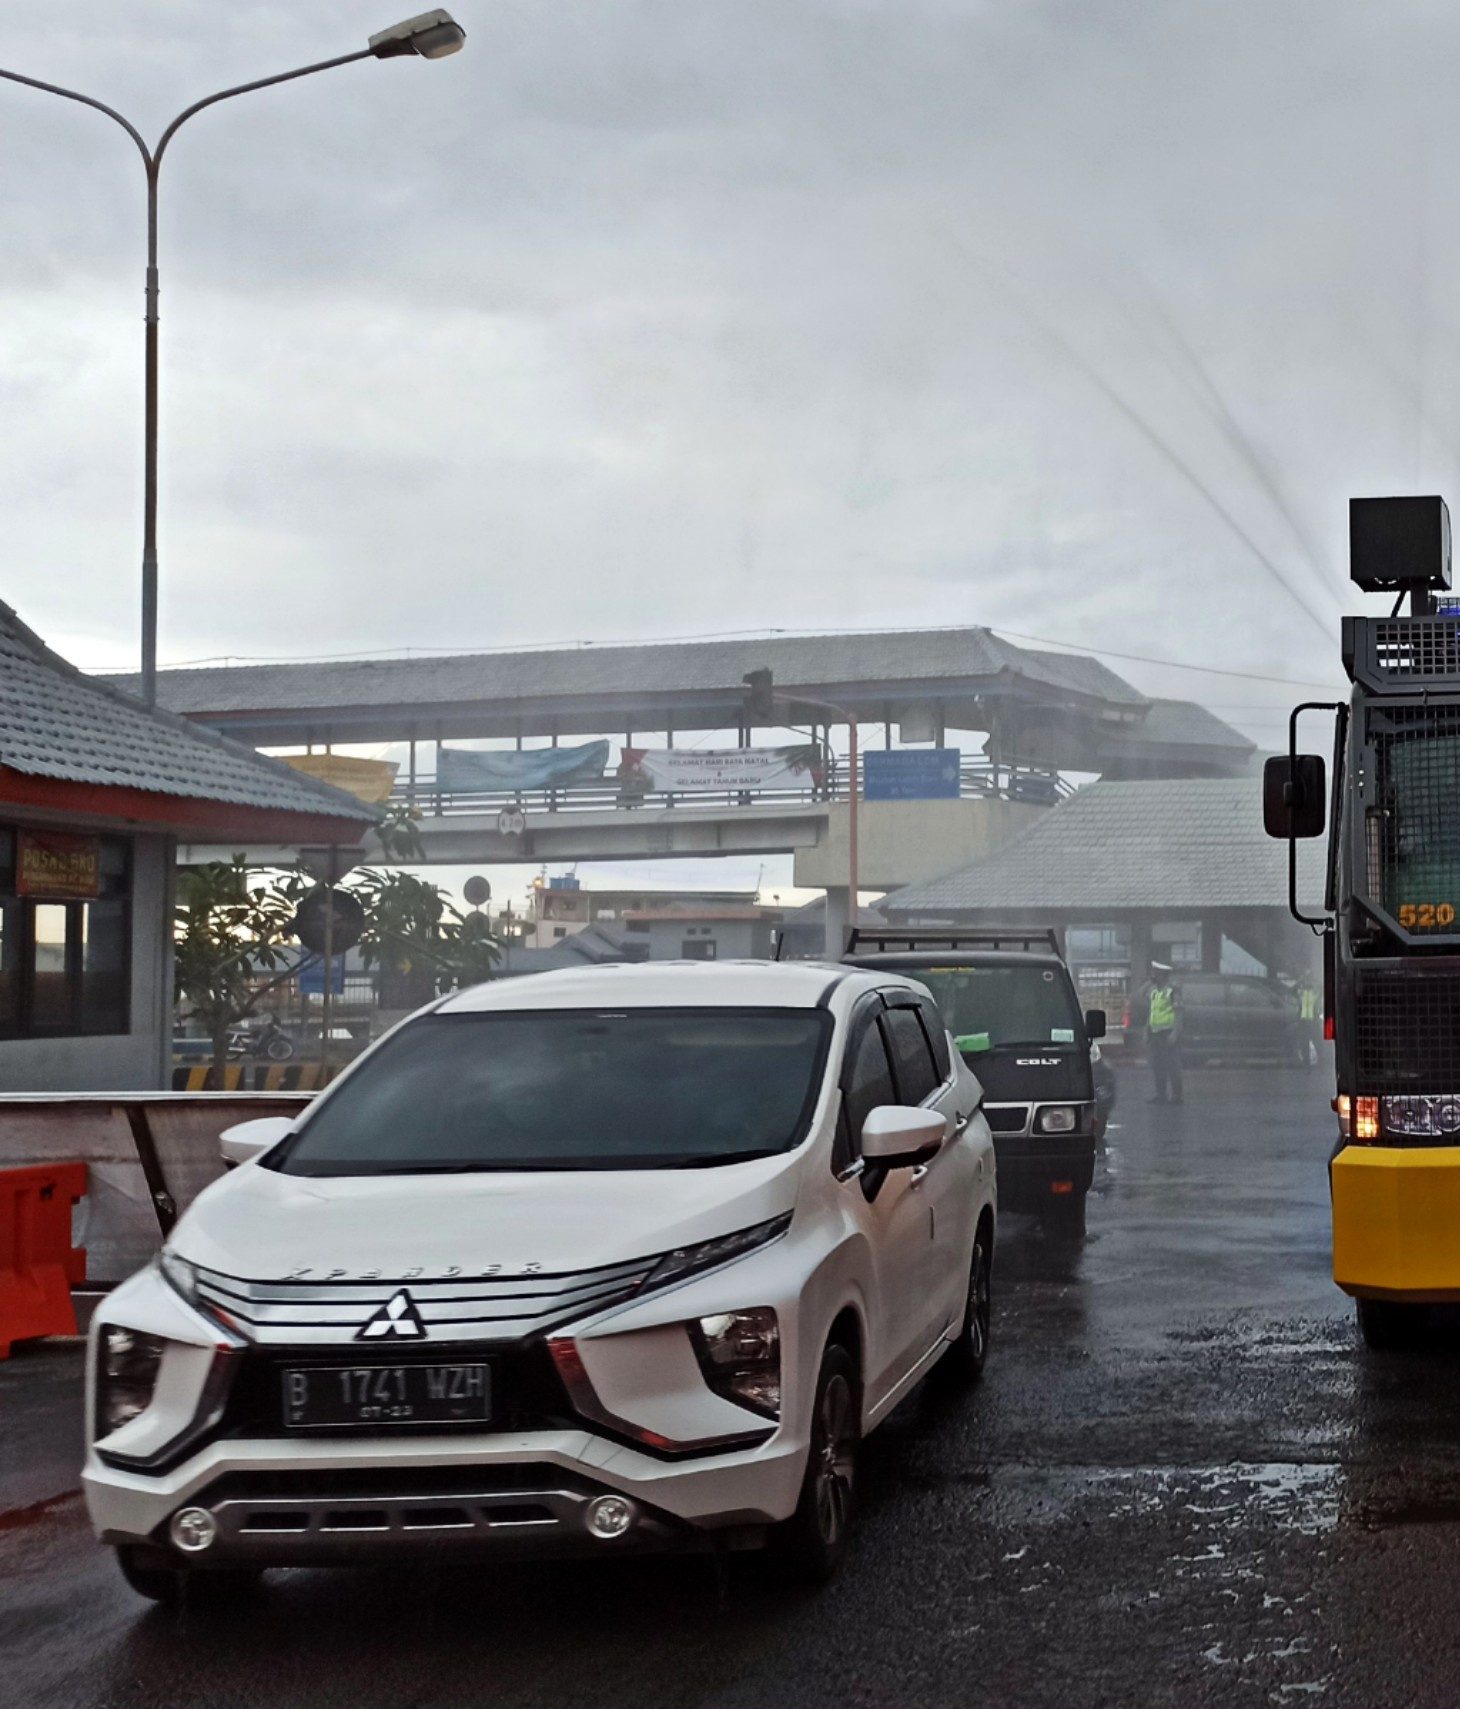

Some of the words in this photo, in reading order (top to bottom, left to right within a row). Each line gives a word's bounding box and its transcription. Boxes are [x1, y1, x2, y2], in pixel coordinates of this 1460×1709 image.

[1399, 903, 1455, 926] 520
[281, 1262, 541, 1281] XPANDER
[289, 1372, 309, 1407] B
[338, 1368, 407, 1404] 1741
[425, 1367, 484, 1400] WZH
